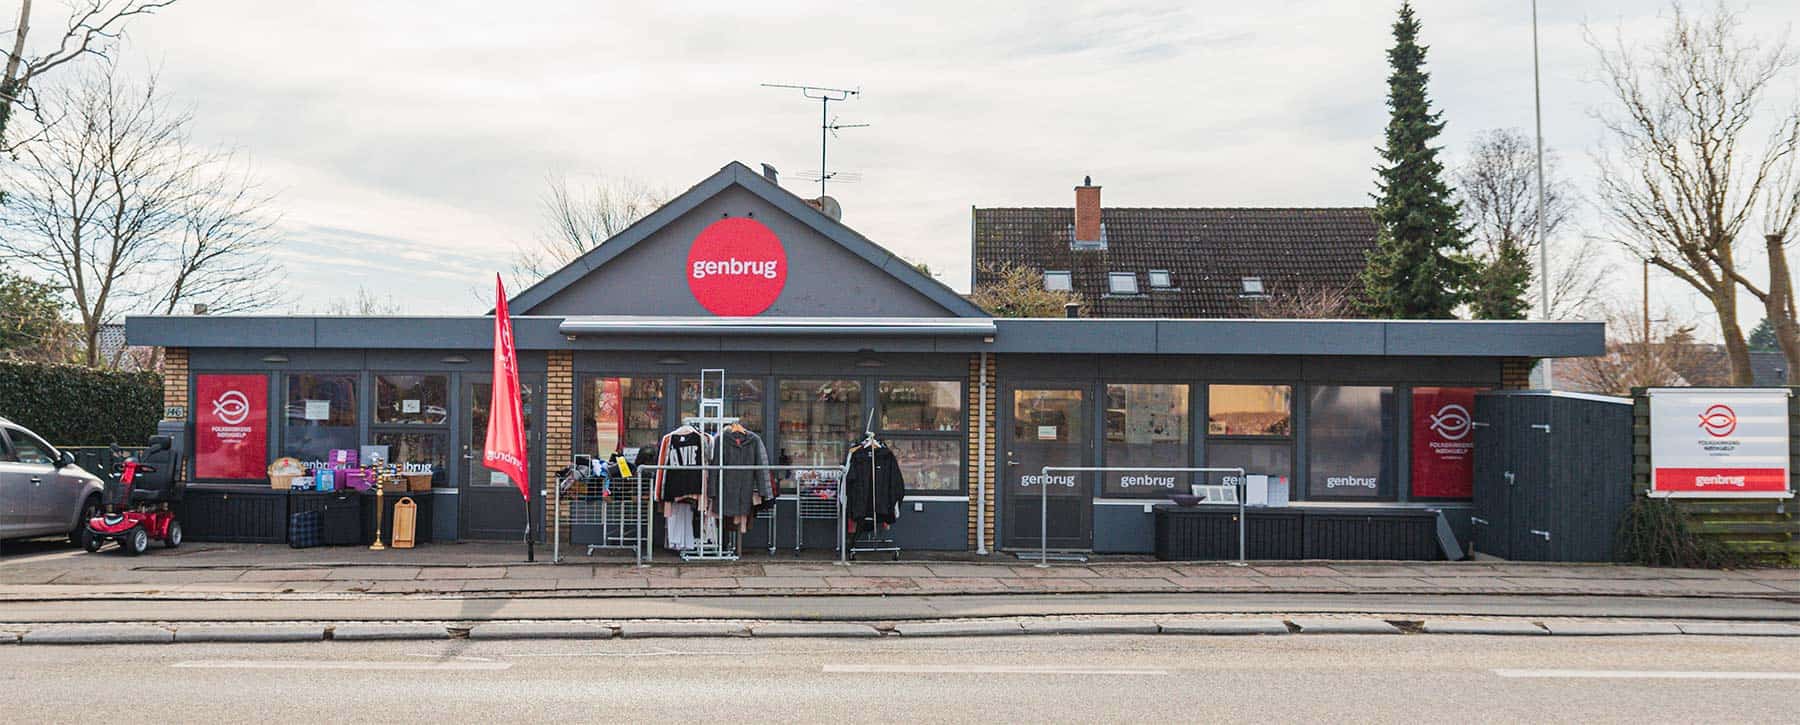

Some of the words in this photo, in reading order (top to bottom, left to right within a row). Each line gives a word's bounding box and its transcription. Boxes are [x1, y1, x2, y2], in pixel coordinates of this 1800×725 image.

[693, 258, 777, 278] genbrug
[1121, 474, 1175, 488] genbrug
[1327, 475, 1376, 488] genbrug
[1696, 474, 1745, 487] genbrug
